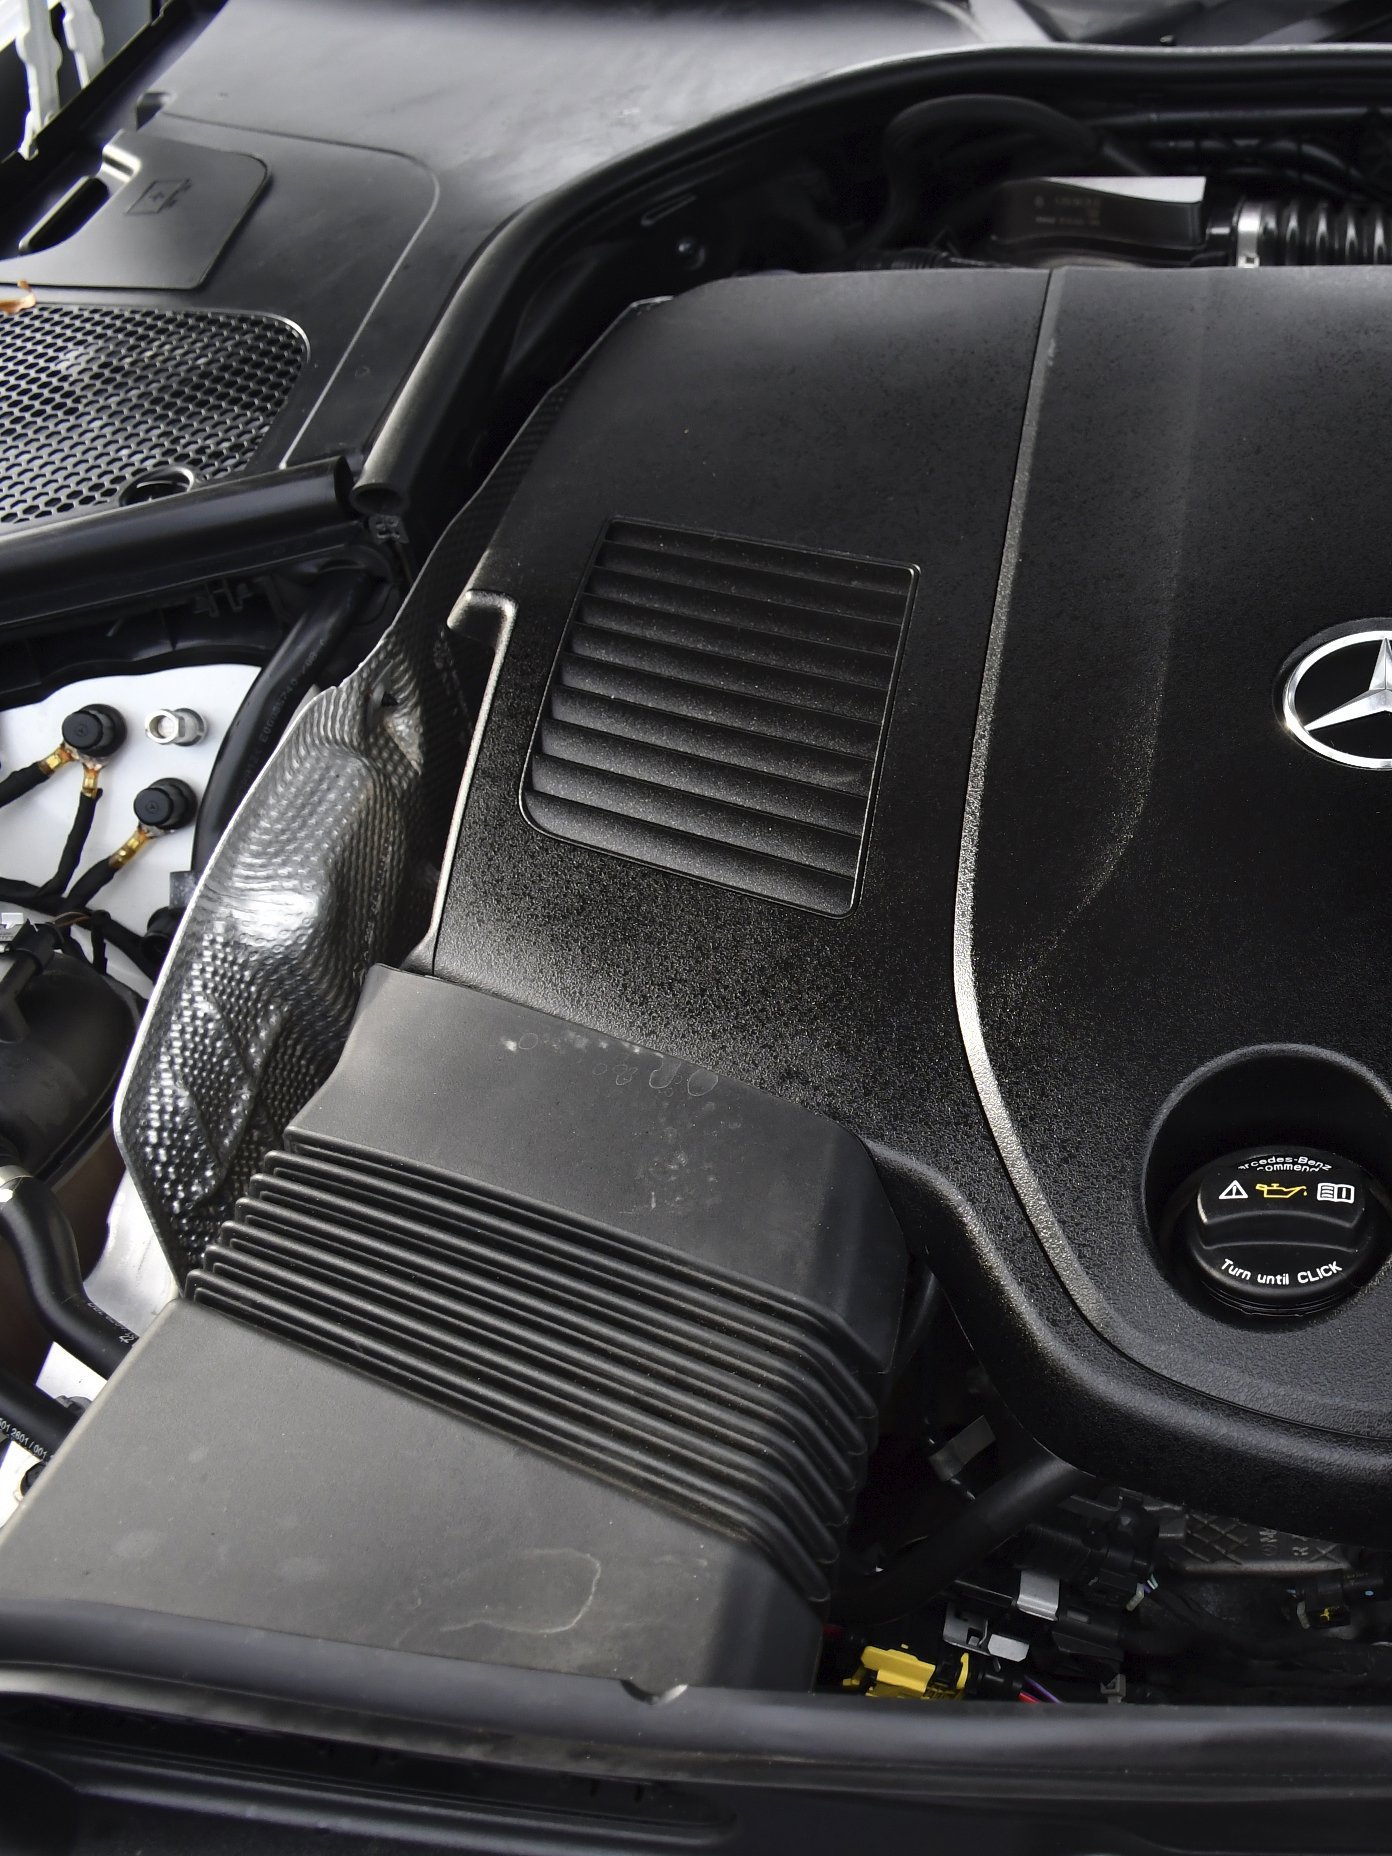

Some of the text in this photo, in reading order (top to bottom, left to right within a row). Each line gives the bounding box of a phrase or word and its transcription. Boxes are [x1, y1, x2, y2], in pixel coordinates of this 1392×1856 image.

[1220, 1258, 1343, 1286] Turn until CLICK
